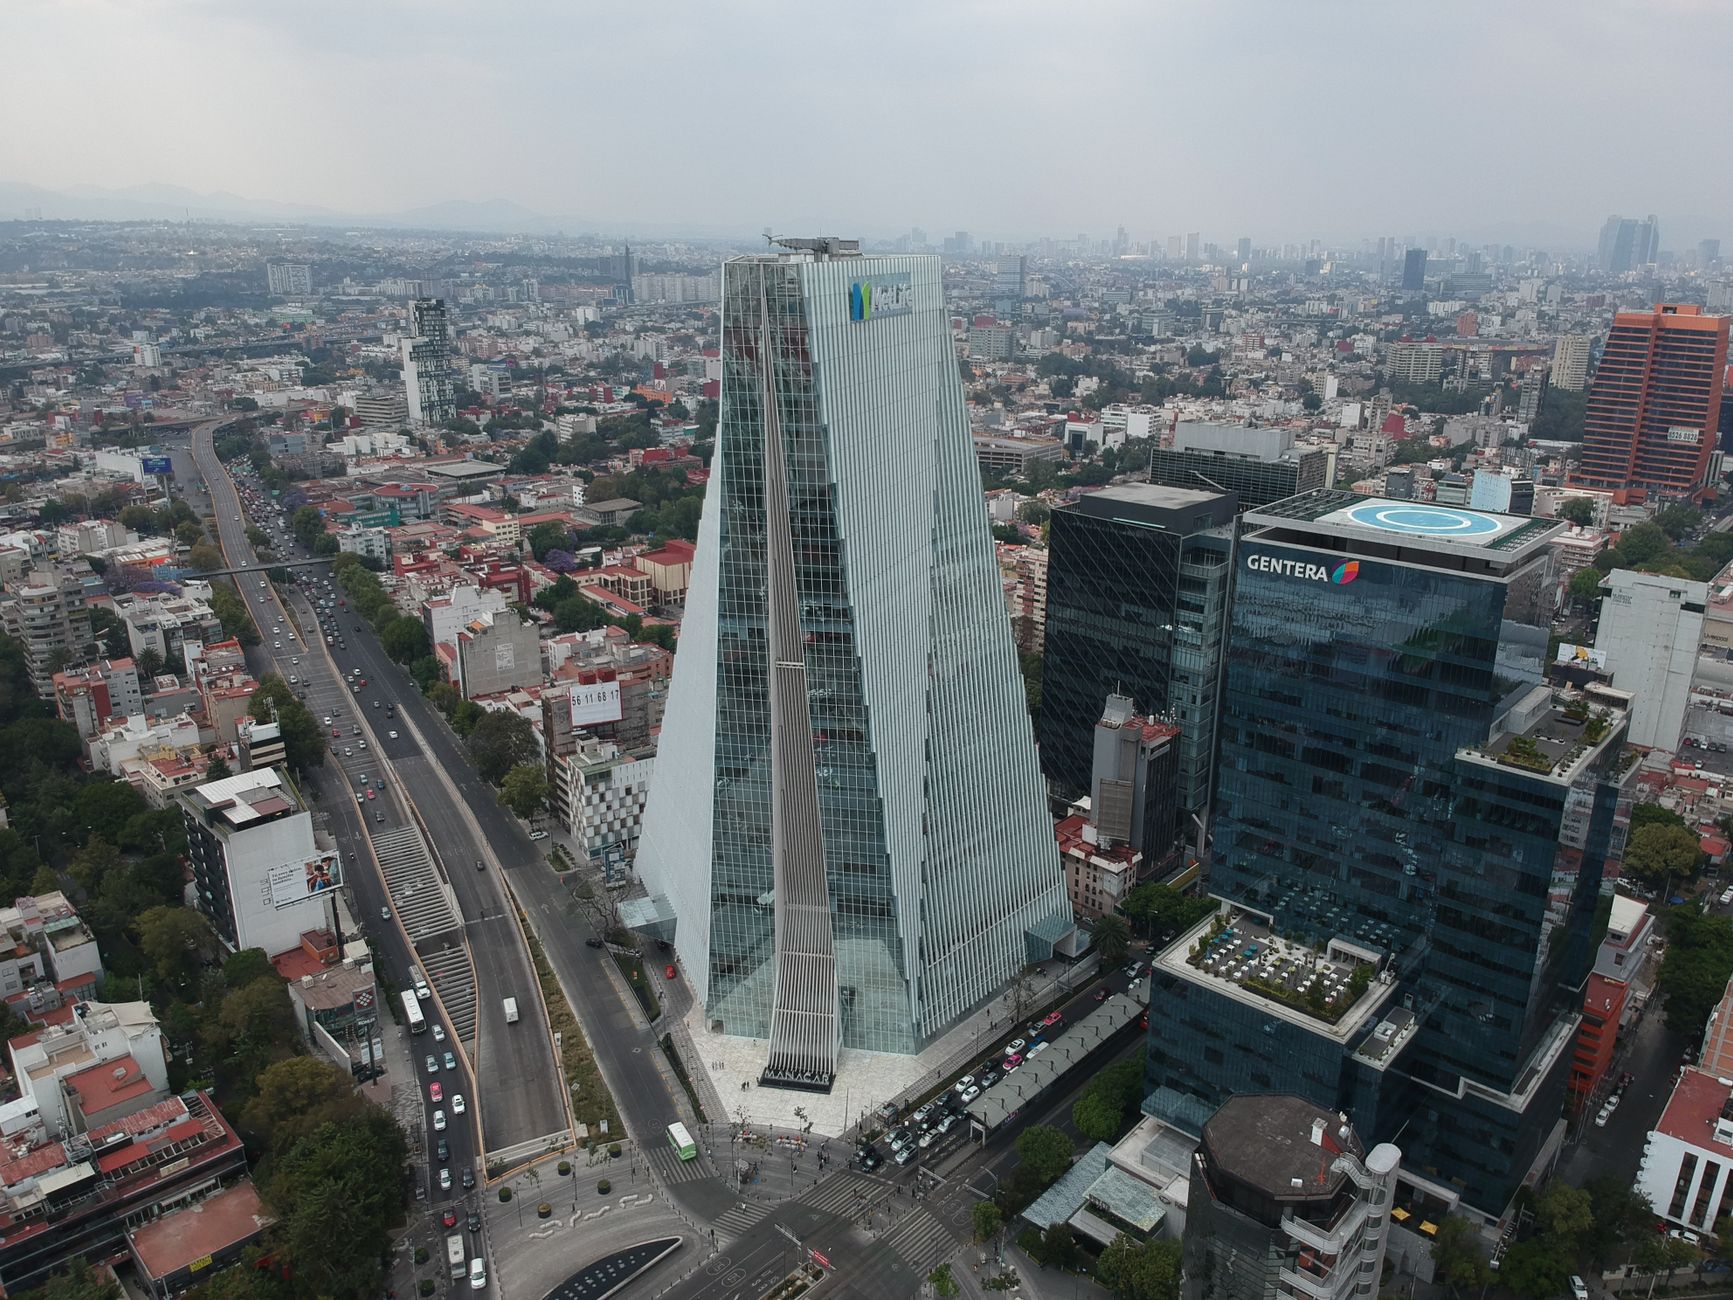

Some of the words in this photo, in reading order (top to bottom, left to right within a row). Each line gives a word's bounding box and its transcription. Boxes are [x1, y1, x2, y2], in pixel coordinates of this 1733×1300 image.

[871, 284, 913, 312] MetLife
[1247, 554, 1328, 582] GENTERA
[572, 695, 581, 706] 56
[585, 693, 593, 704] 11
[597, 691, 607, 702] 68
[611, 689, 619, 700] 17
[764, 1069, 830, 1085] MANACAR
